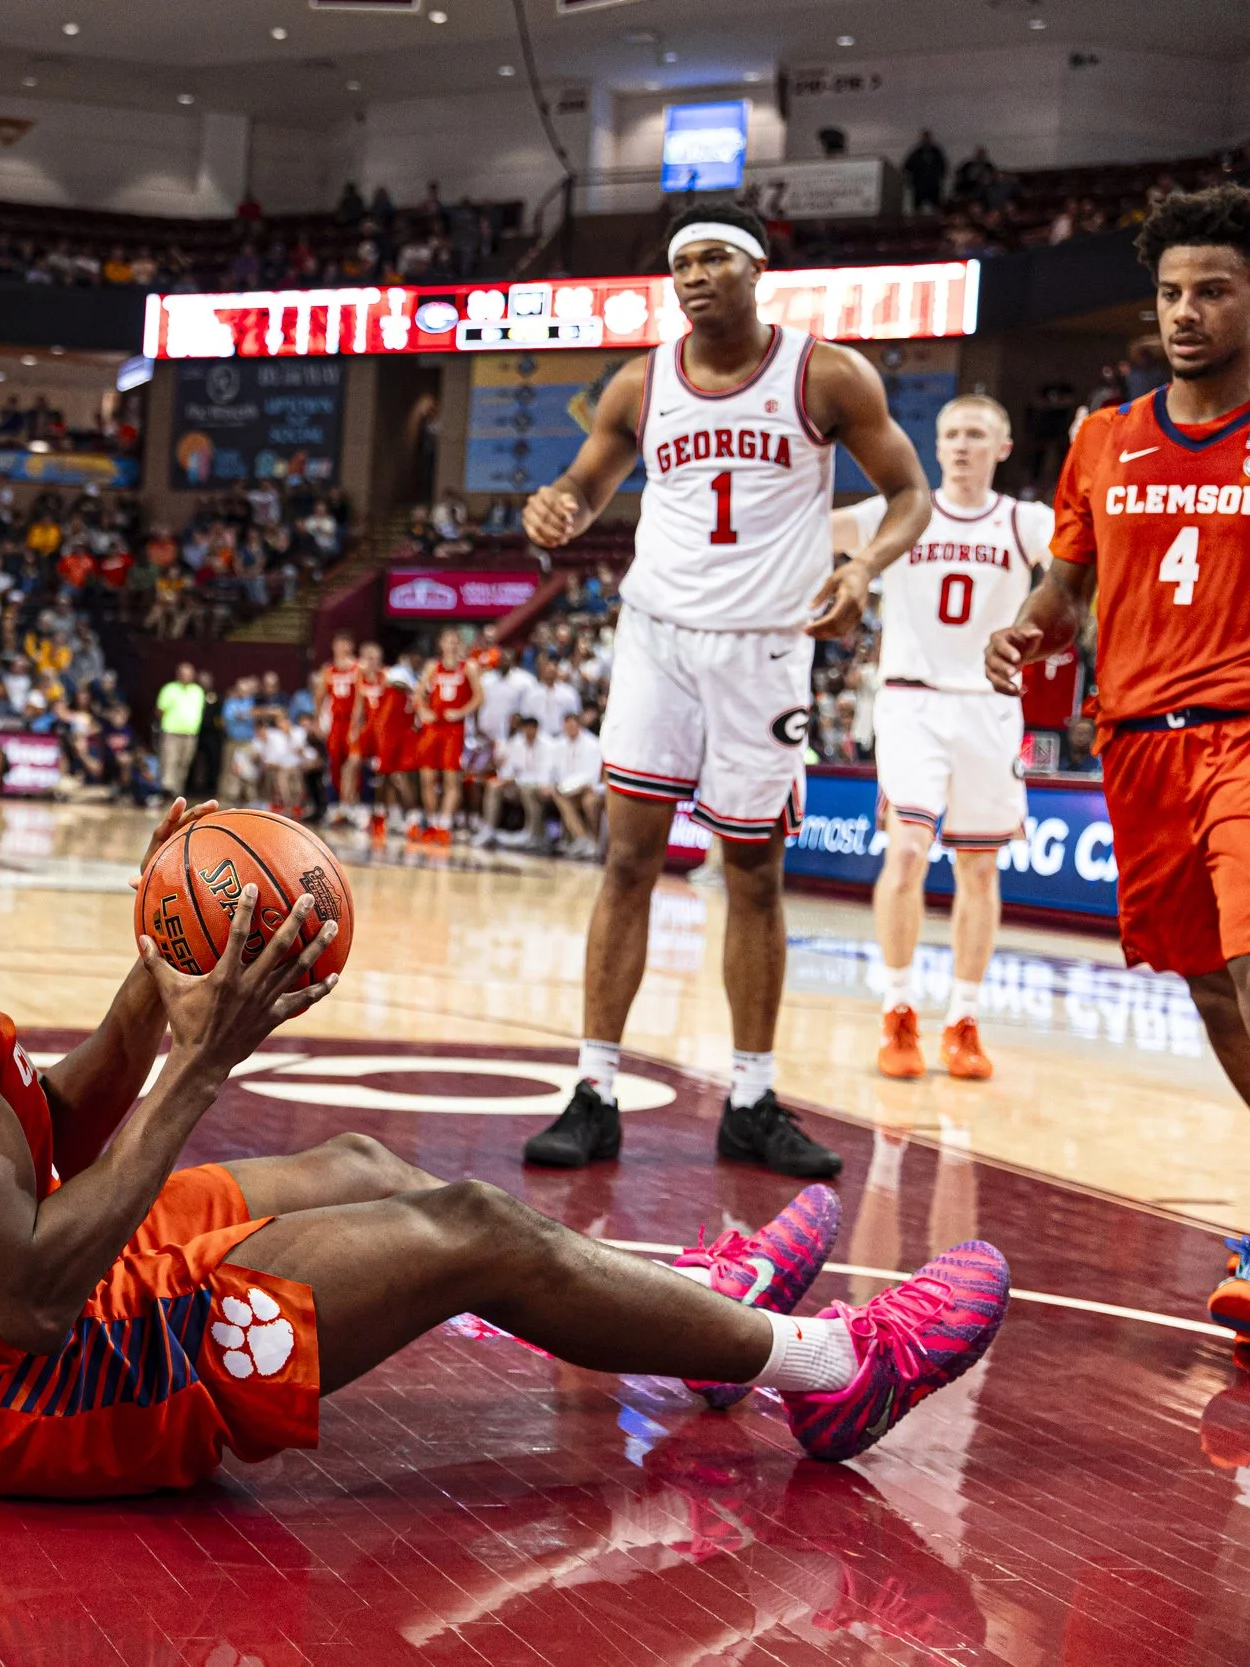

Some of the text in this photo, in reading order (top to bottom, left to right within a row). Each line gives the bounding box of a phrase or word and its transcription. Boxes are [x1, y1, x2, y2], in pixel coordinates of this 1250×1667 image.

[657, 429, 791, 474] GEORGIA
[710, 471, 737, 544] 1
[910, 543, 1010, 571] GEORGIA
[1158, 526, 1200, 605] 4
[938, 573, 974, 625] 0
[161, 893, 204, 976] LEGA
